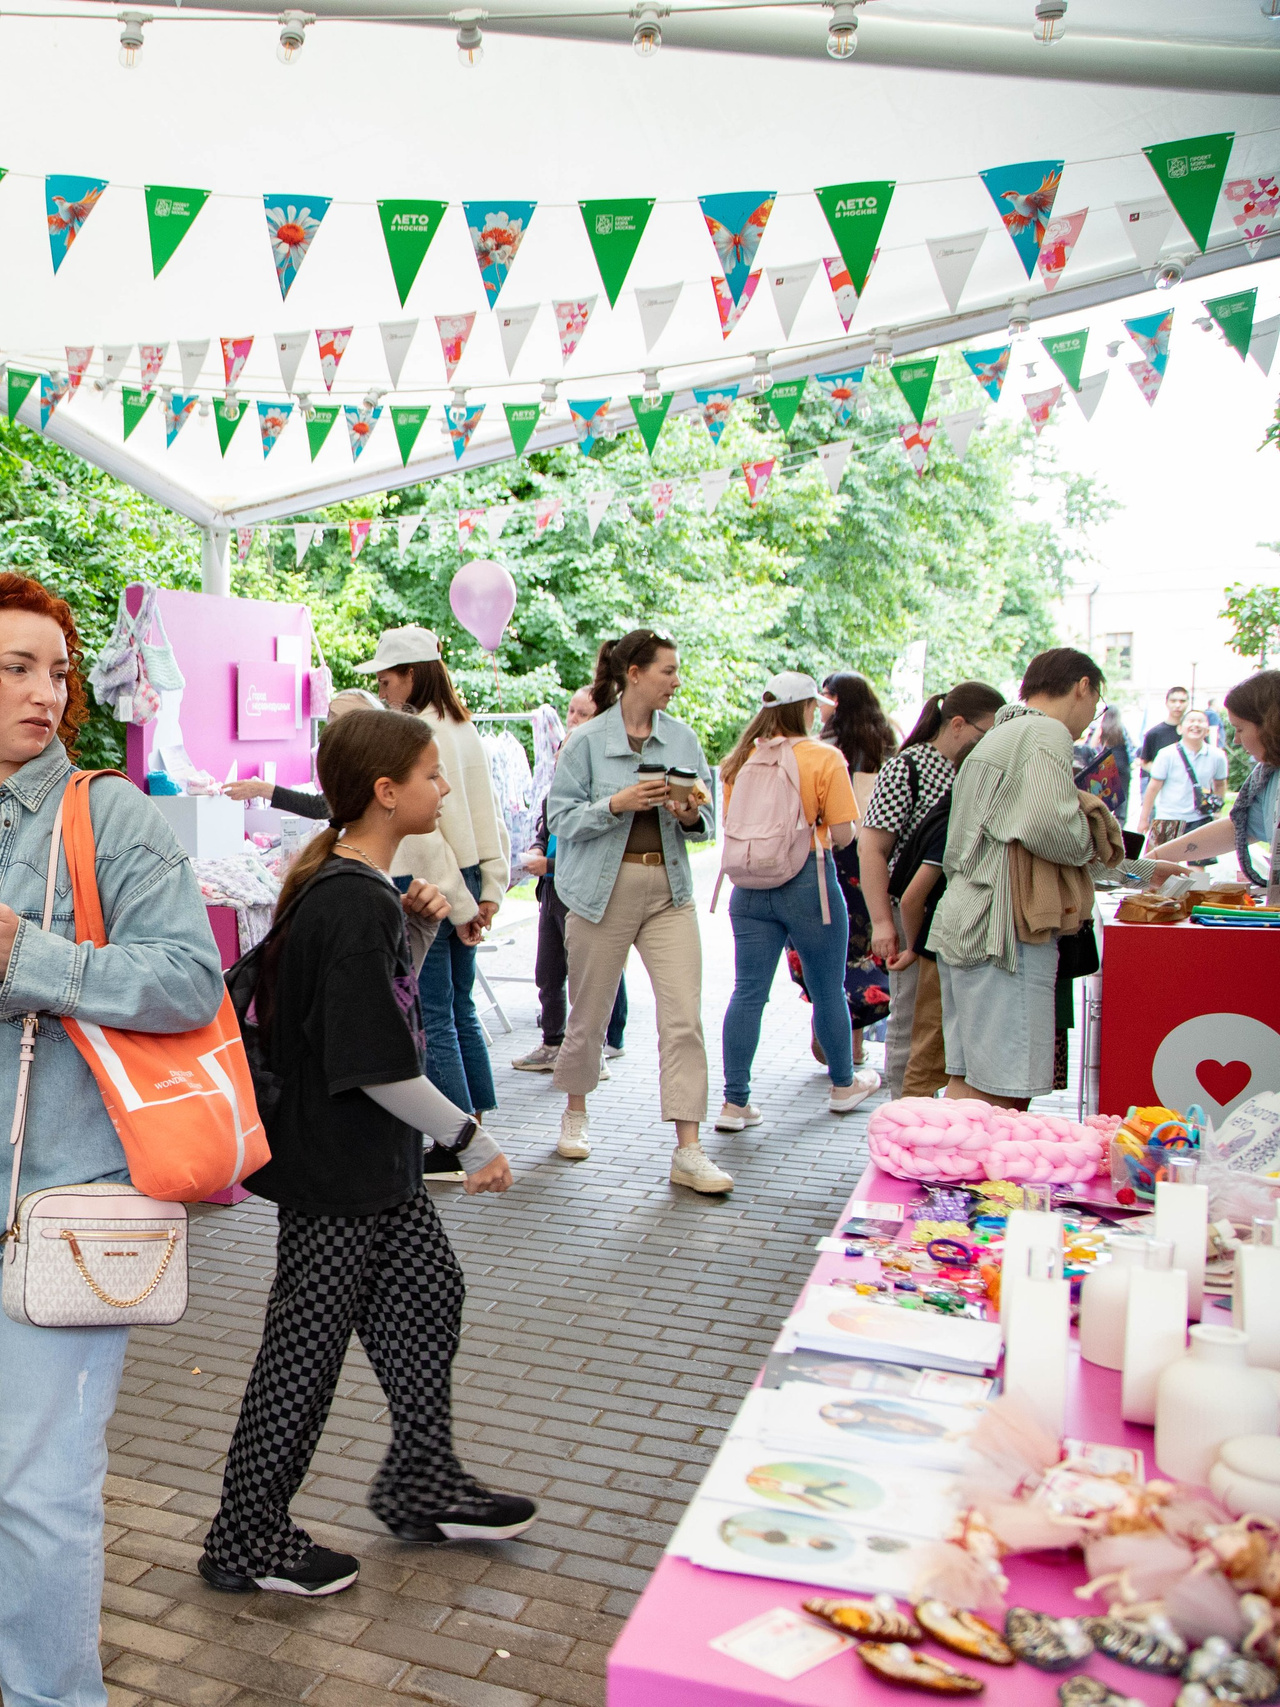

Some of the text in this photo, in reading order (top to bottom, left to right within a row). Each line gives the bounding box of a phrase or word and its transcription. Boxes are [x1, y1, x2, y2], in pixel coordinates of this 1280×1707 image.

[1190, 154, 1212, 163] ПРОЕКТ
[835, 197, 878, 212] ЛЕТО
[843, 207, 878, 217] МОСКВЕ
[391, 214, 429, 225] ЛЕТО
[1052, 338, 1080, 350] ЛЕТО
[771, 386, 797, 396] ЛЕТО
[512, 410, 535, 418] ЛЕТО
